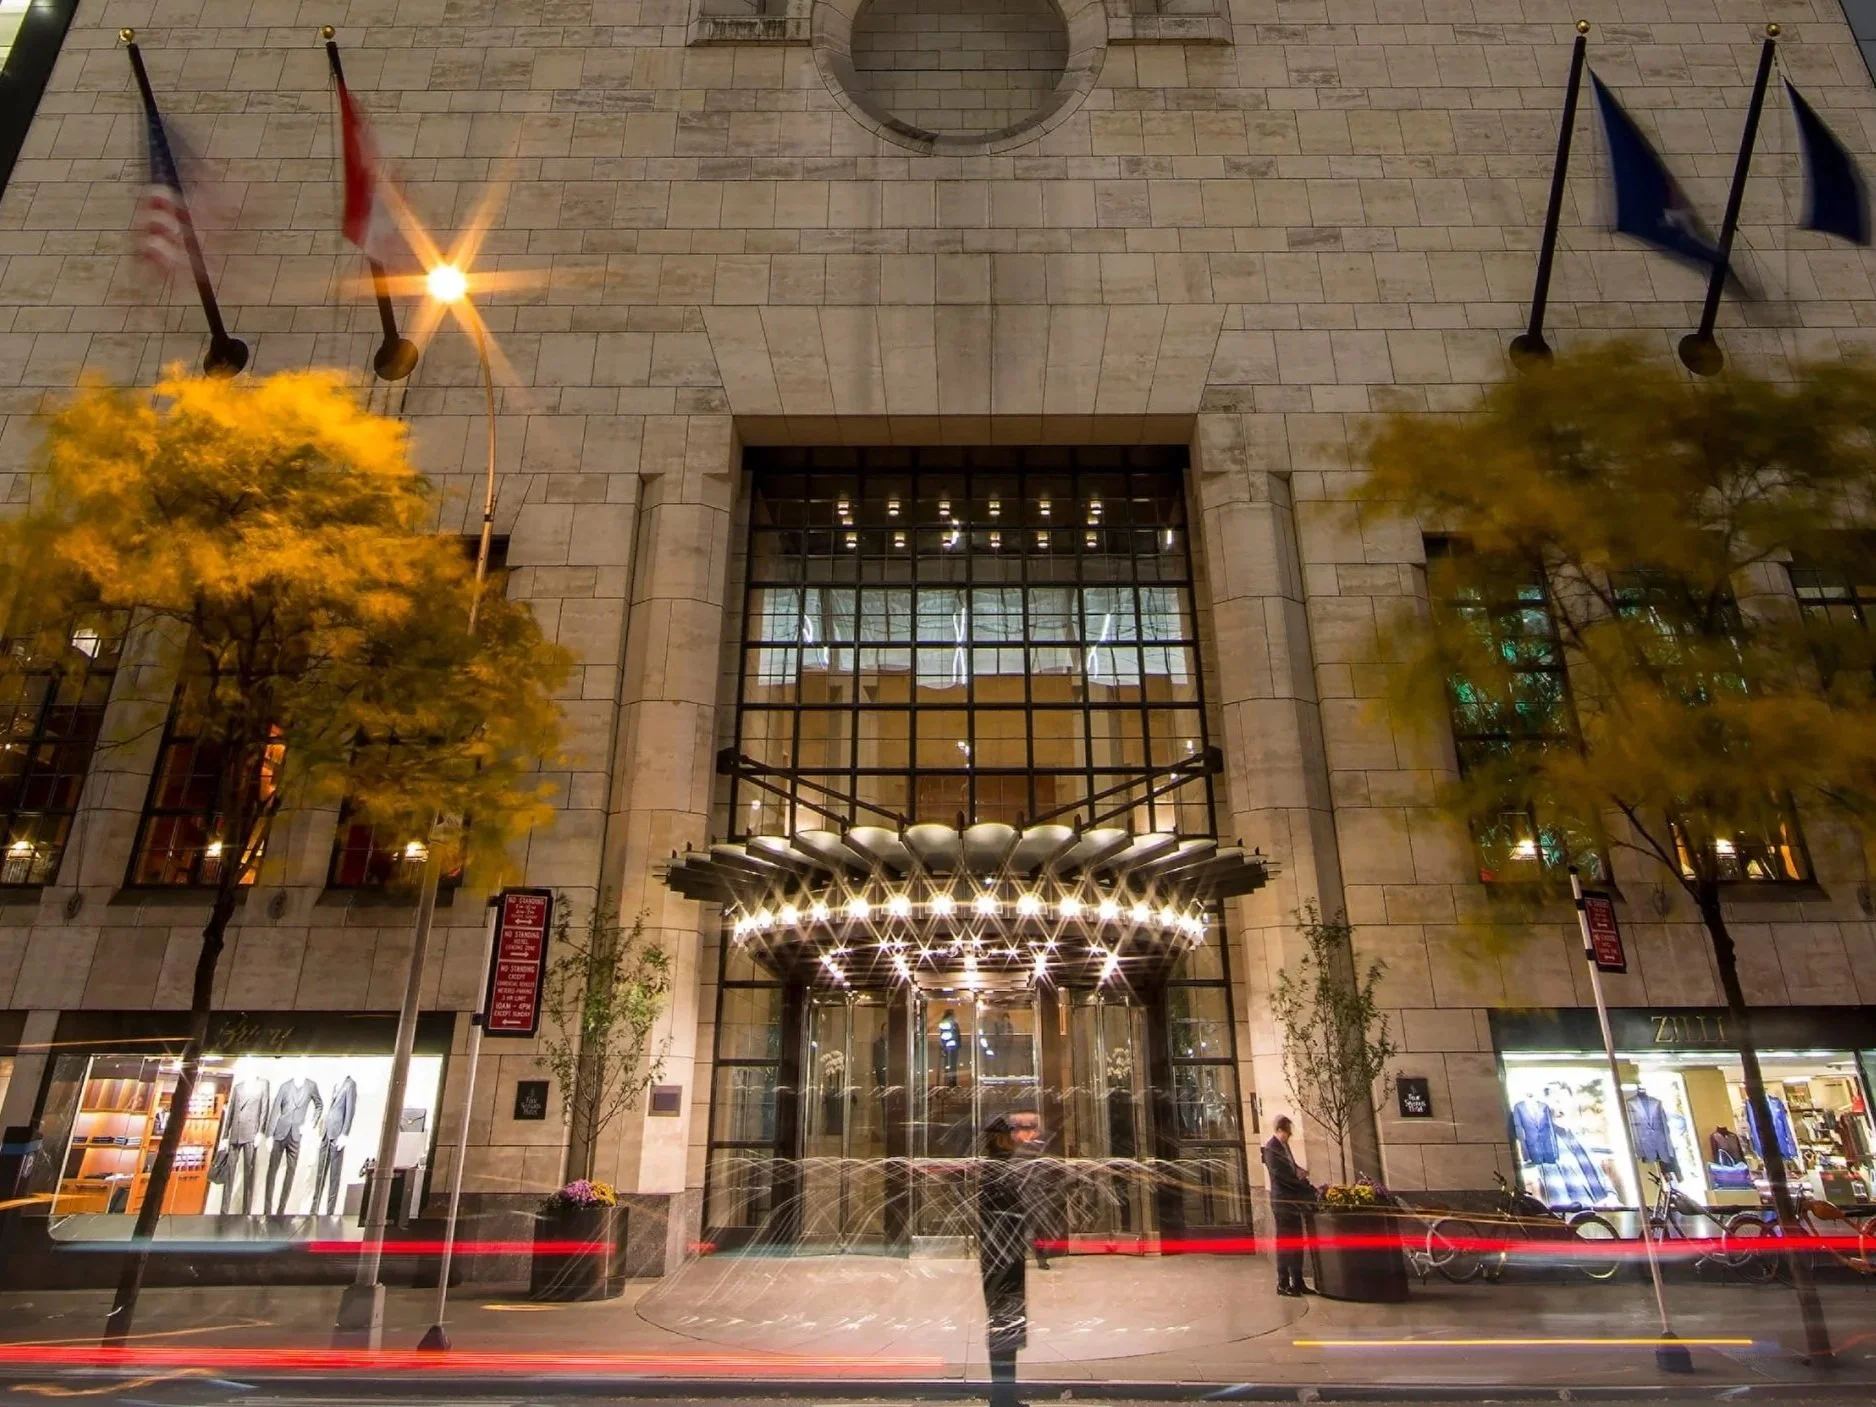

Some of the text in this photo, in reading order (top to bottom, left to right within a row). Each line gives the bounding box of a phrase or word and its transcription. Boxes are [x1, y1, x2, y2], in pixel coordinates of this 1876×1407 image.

[515, 931, 540, 939] STANDING
[510, 965, 535, 973] STANDING
[1651, 1016, 1728, 1042] ZILLI
